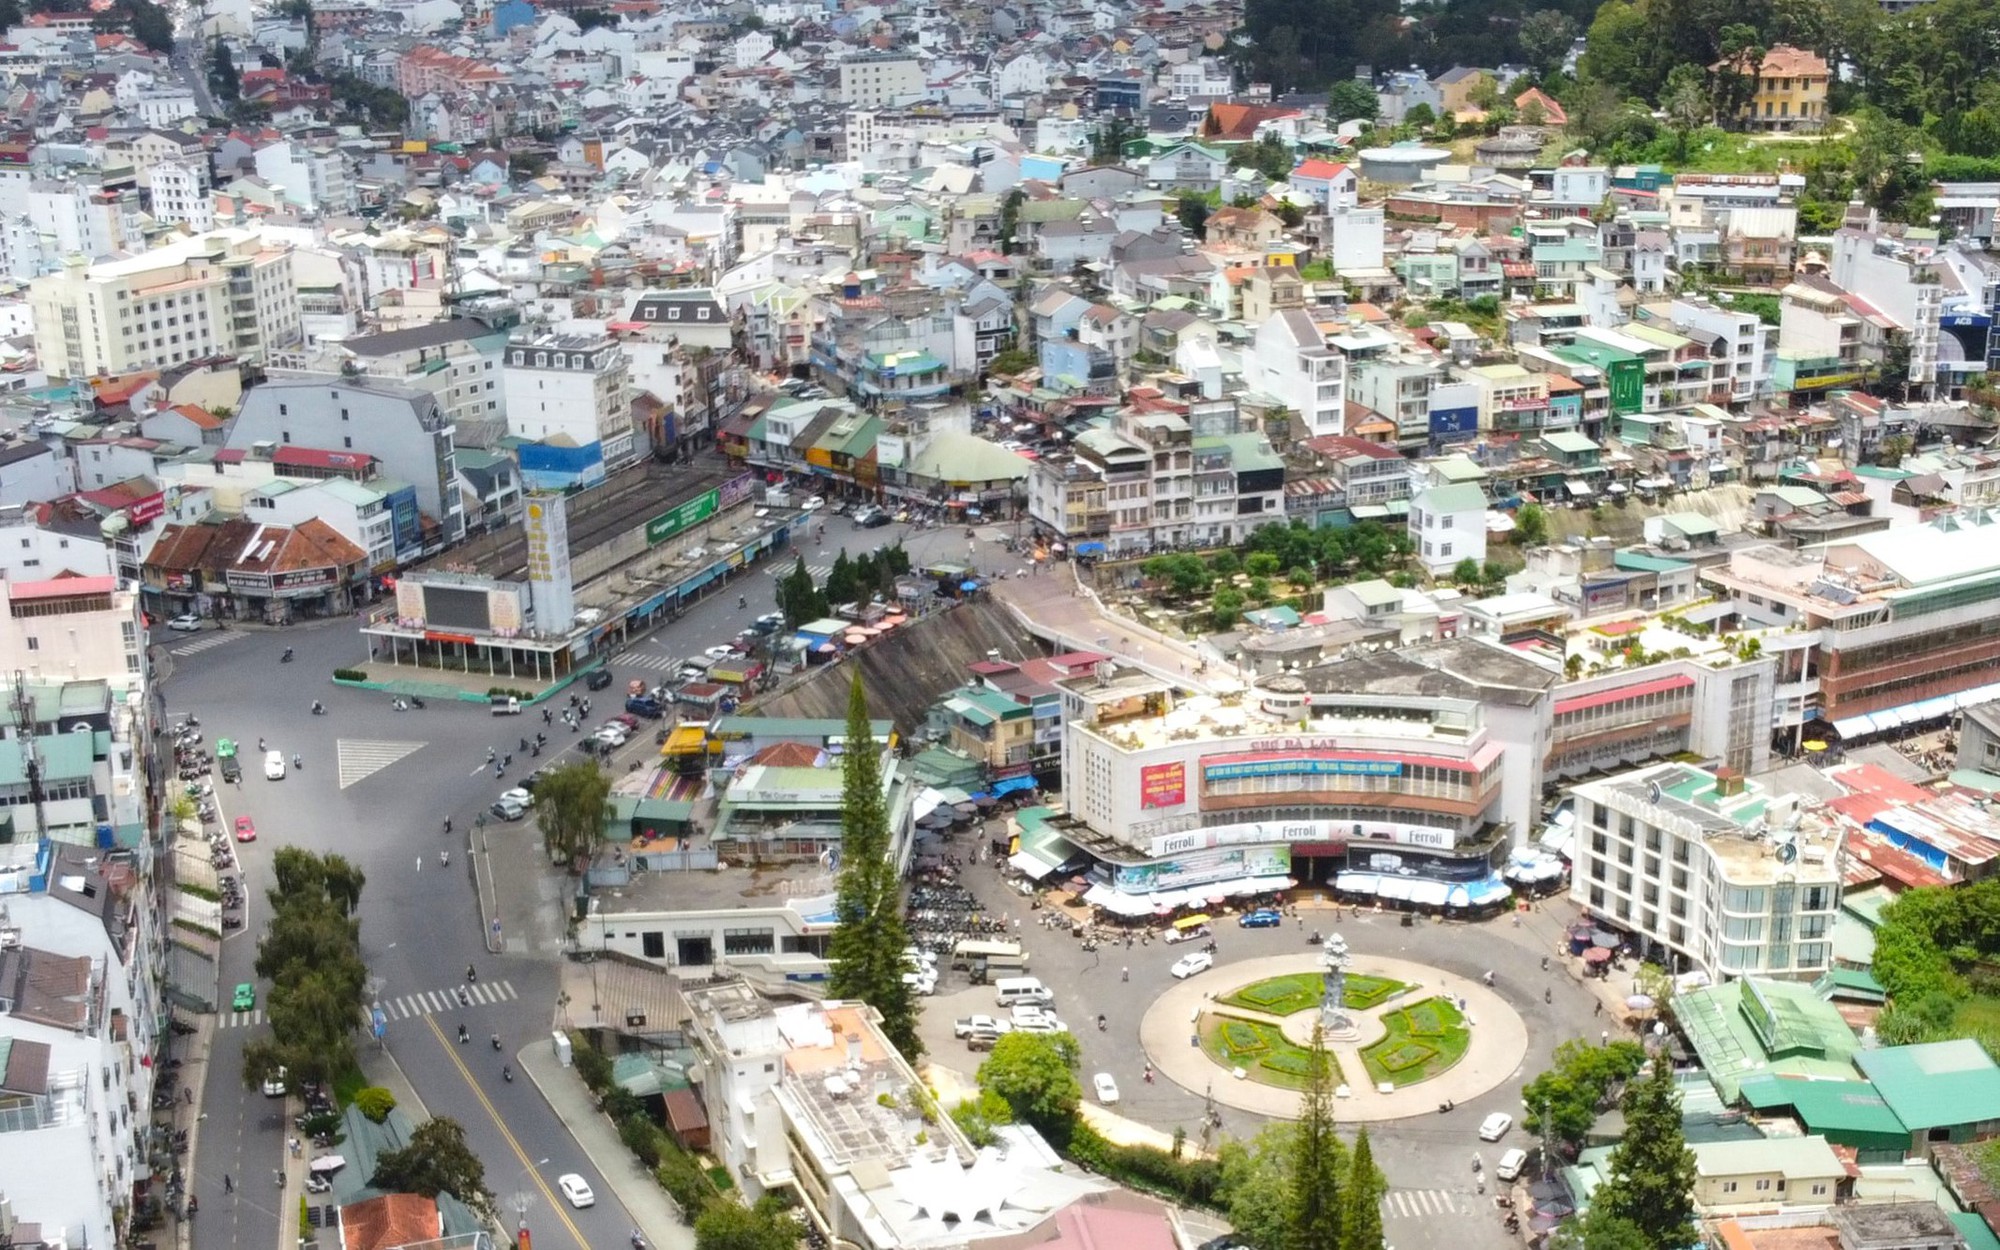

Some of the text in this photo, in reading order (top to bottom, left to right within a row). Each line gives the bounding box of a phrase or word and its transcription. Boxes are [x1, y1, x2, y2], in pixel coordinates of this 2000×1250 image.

[1953, 317, 1972, 326] ACB
[1282, 825, 1317, 839] Ferroli
[1408, 830, 1443, 845] Ferroli
[1163, 835, 1195, 853] Ferroli
